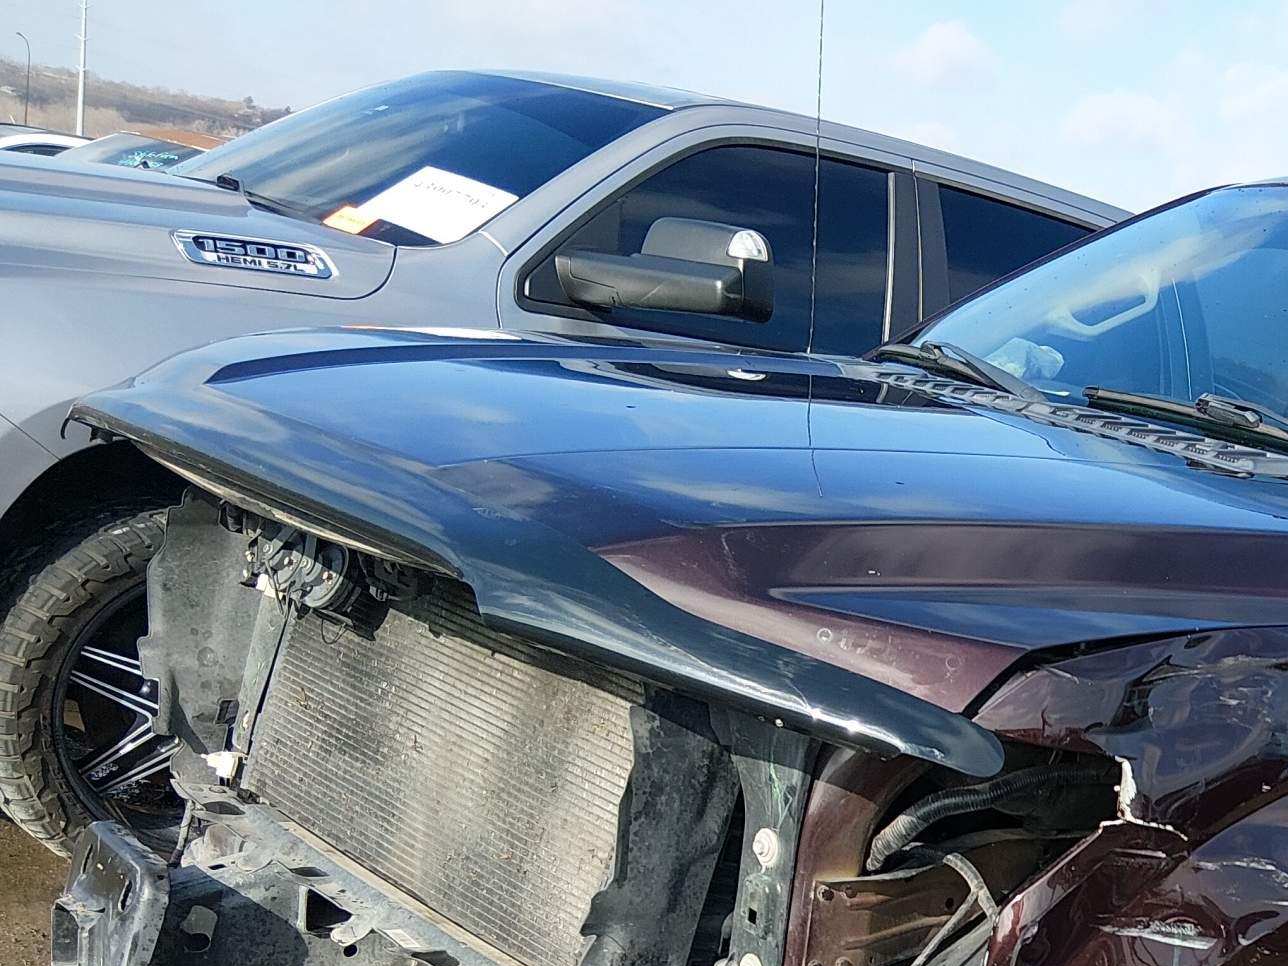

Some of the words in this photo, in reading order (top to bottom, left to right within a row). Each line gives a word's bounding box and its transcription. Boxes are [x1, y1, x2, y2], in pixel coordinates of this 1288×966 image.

[198, 239, 306, 262] 1500
[216, 255, 262, 267] HEMI
[266, 261, 305, 273] 5.7L
